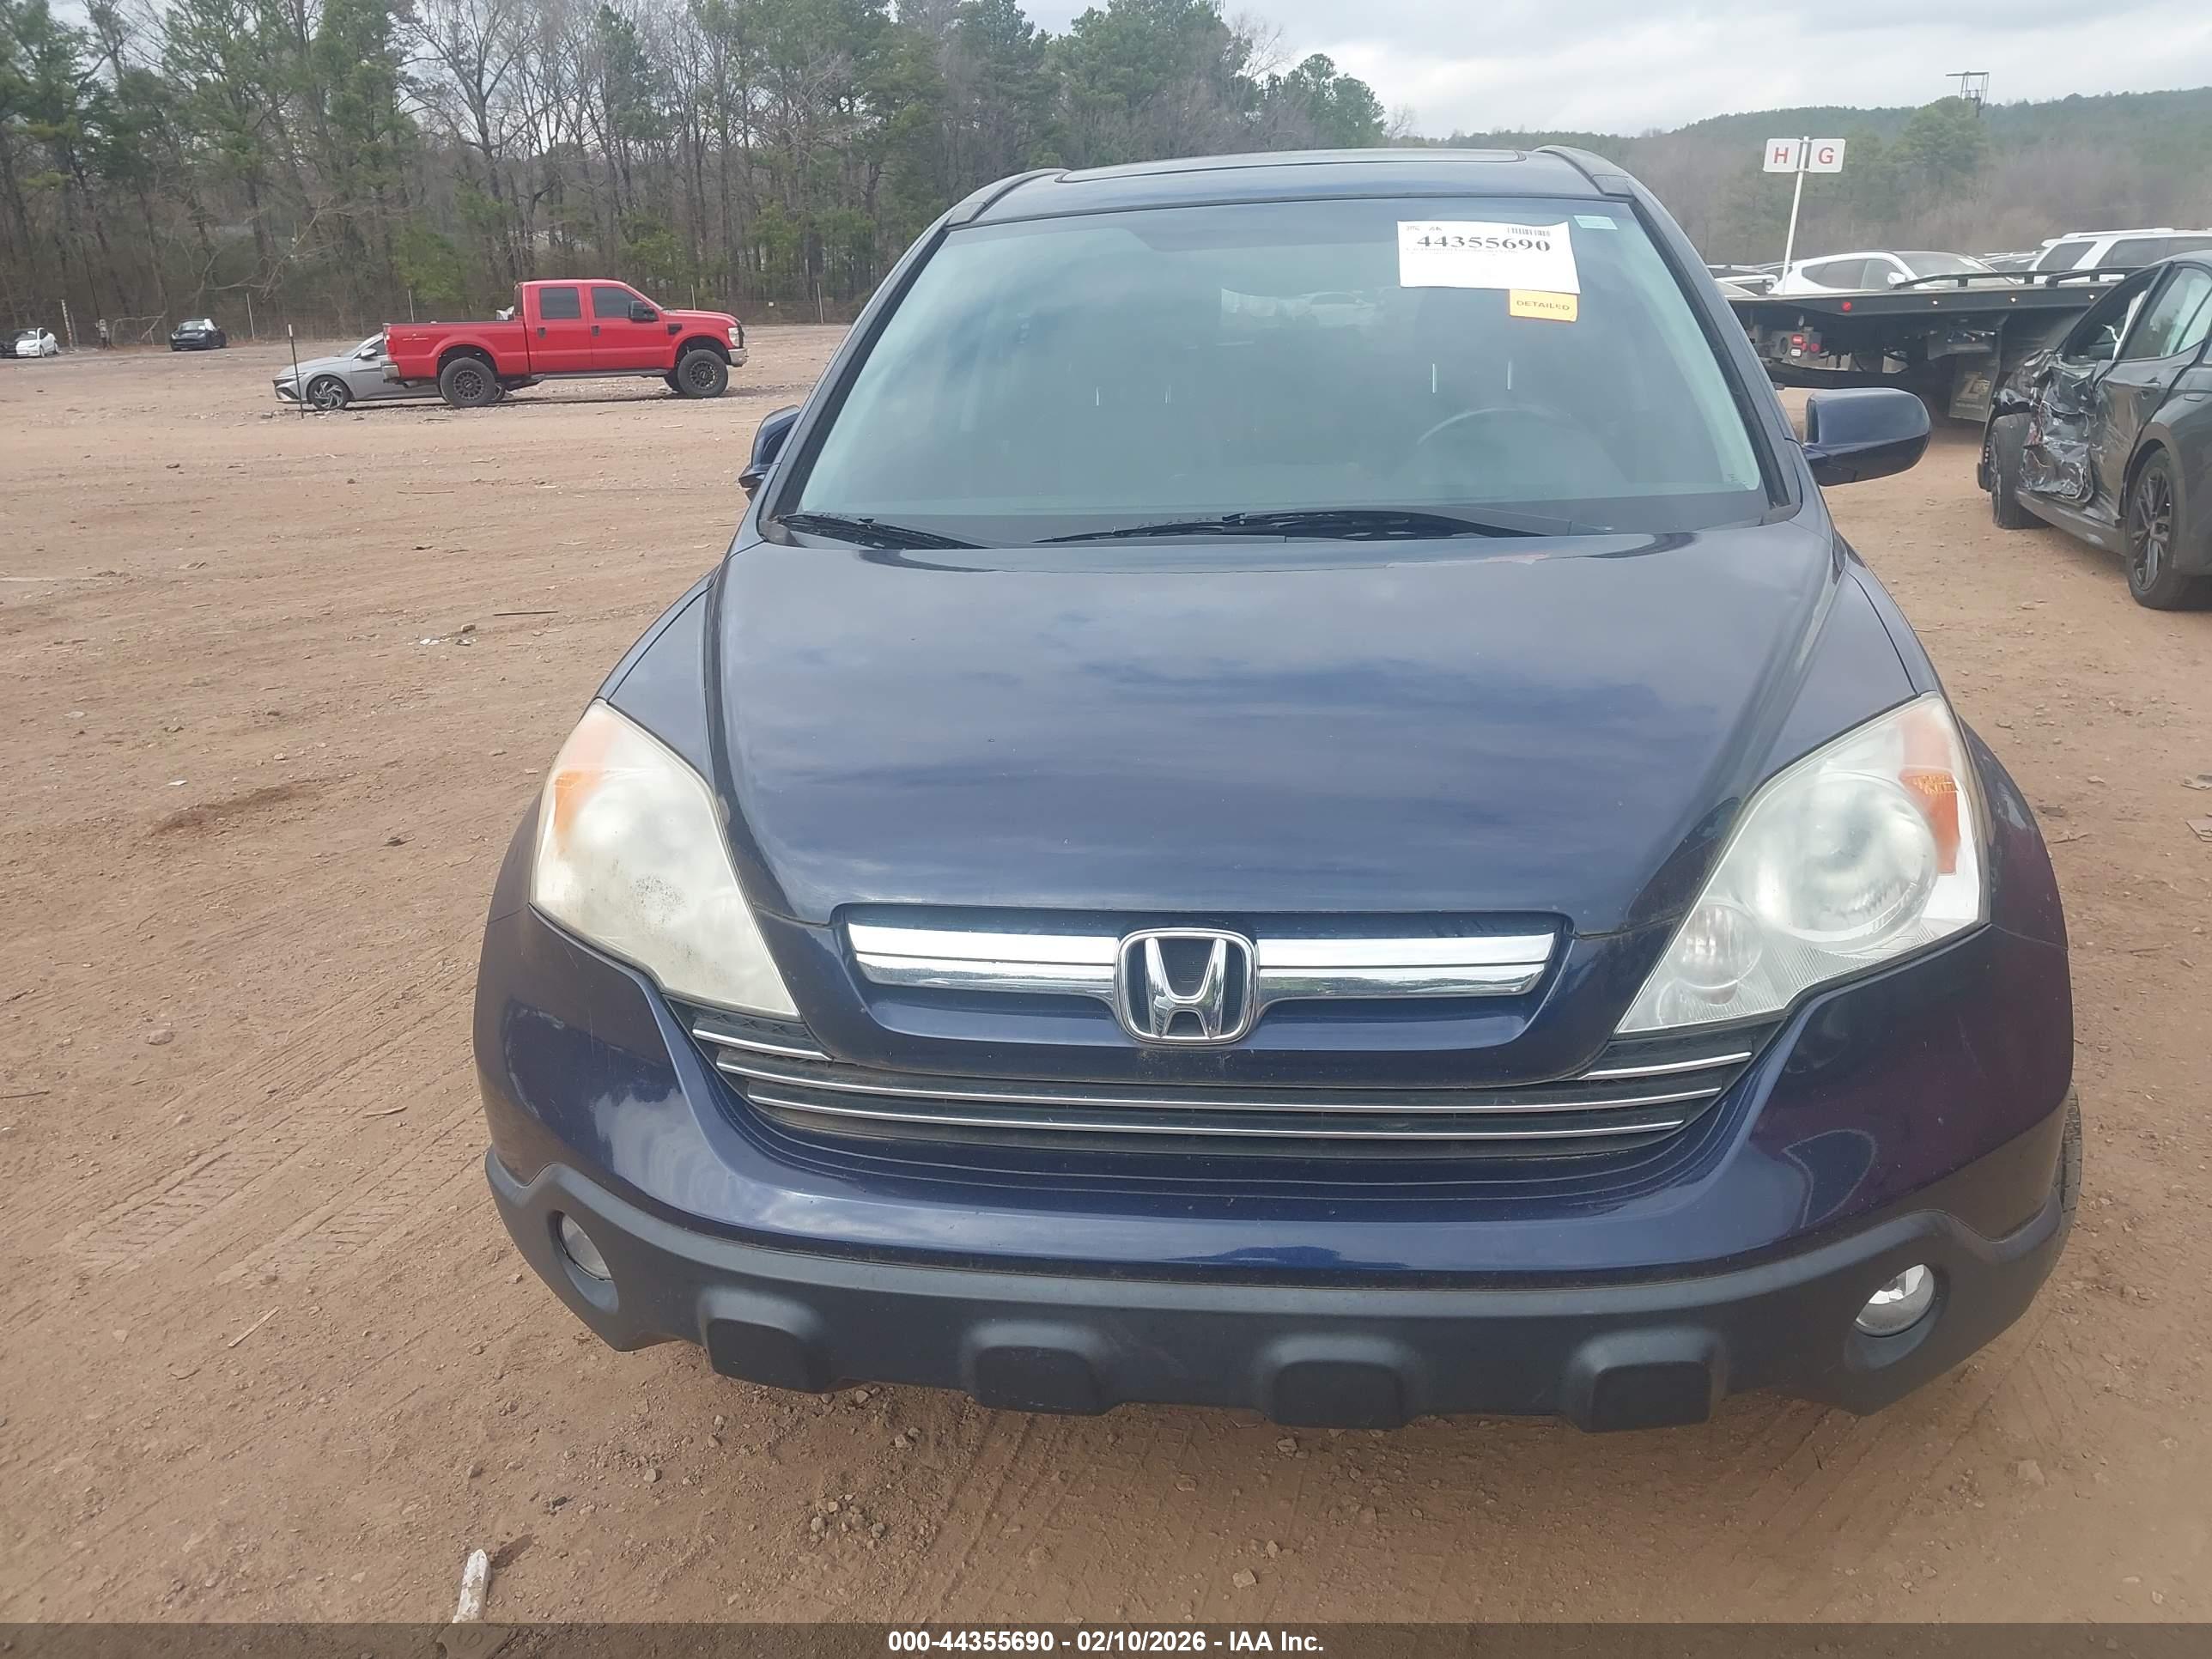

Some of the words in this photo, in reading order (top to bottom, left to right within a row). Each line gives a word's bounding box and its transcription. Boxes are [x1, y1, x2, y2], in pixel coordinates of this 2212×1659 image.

[1772, 147, 1790, 164] H
[1818, 147, 1835, 164] G
[1417, 235, 1551, 252] 44355690
[1516, 300, 1571, 311] DETAILED
